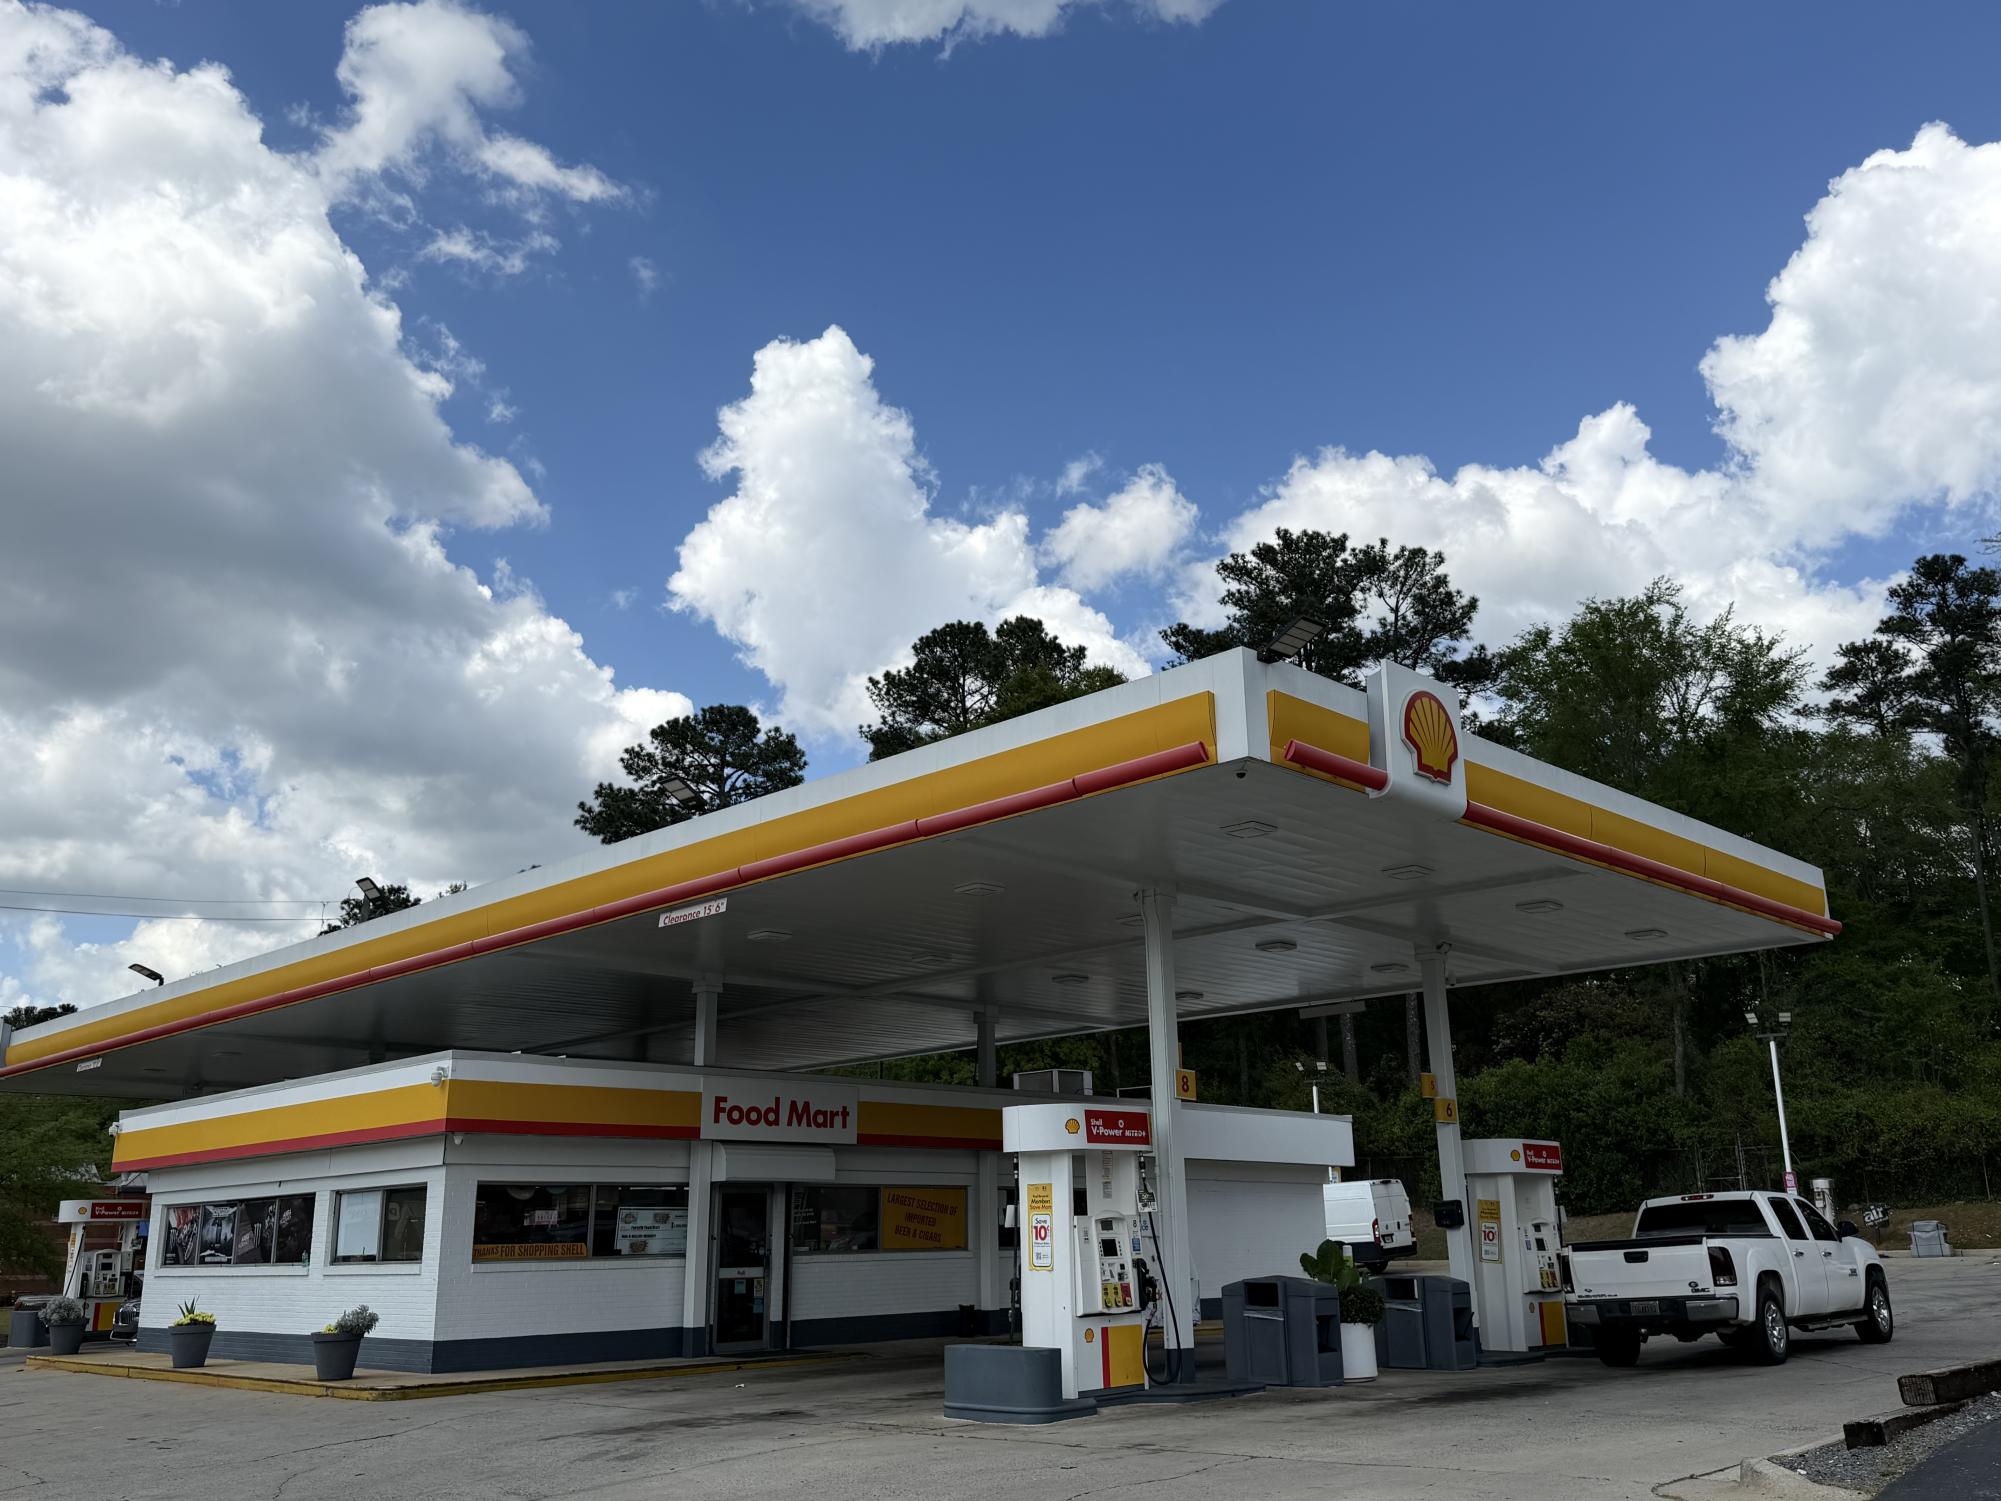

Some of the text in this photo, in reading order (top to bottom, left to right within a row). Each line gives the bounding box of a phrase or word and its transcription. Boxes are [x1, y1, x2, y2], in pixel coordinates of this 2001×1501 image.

[664, 910, 700, 925] Clearance
[1181, 1074, 1190, 1093] 8
[713, 1095, 850, 1129] Food Mart
[1446, 1103, 1453, 1117] 6
[1091, 1126, 1122, 1137] V-Power
[888, 1192, 959, 1216] LARGEST SELECTION OF
[905, 1211, 936, 1227] IMPORTED
[1864, 1205, 1883, 1222] air
[895, 1224, 911, 1237] BEER
[919, 1230, 941, 1242] CIGARS
[501, 1245, 516, 1257] FOR
[518, 1244, 558, 1257] SHOPPING
[561, 1243, 584, 1256] SHELL
